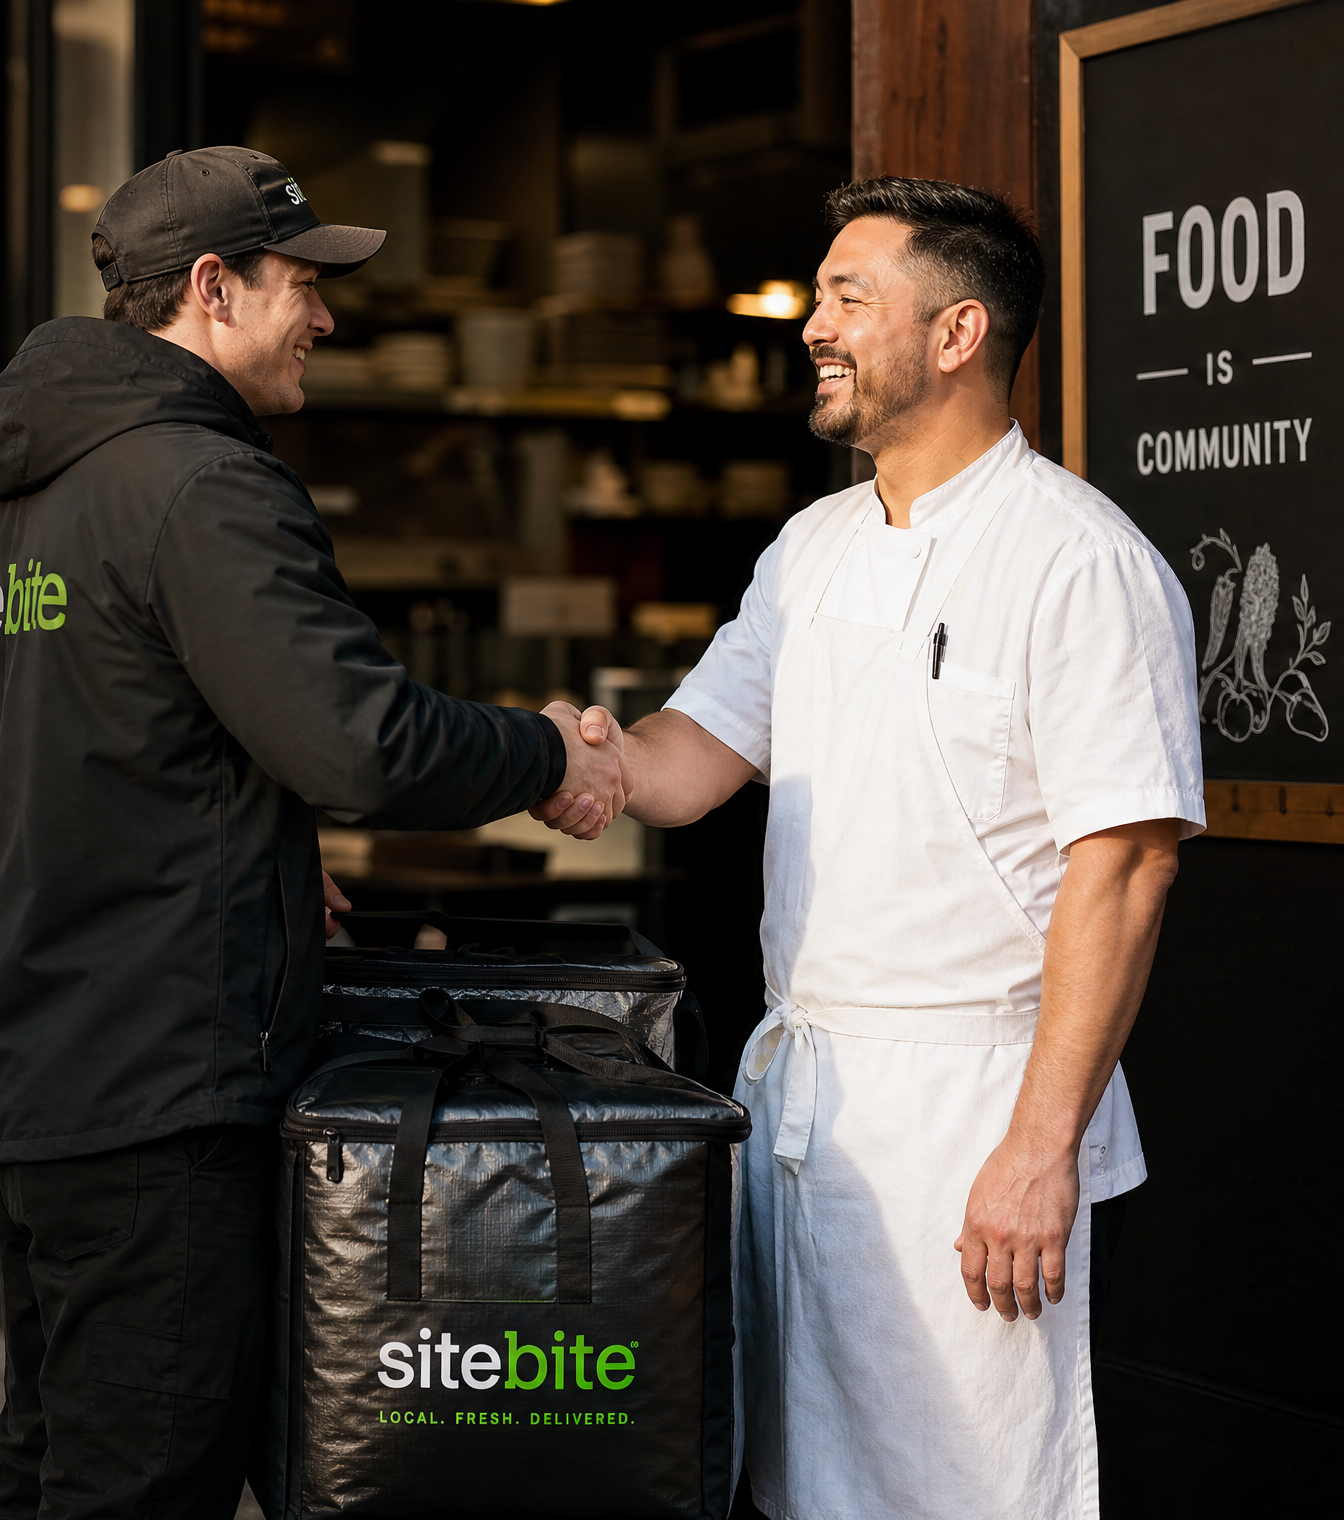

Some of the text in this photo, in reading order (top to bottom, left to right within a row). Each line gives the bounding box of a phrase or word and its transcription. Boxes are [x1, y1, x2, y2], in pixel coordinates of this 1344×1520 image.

[1142, 189, 1306, 316] FOOD
[1206, 350, 1234, 386] IS
[1136, 417, 1313, 476] COMMUNITY
[377, 1327, 636, 1390] sitebite
[379, 1410, 635, 1426] LOCAL. FRESH. DELIVERED.
